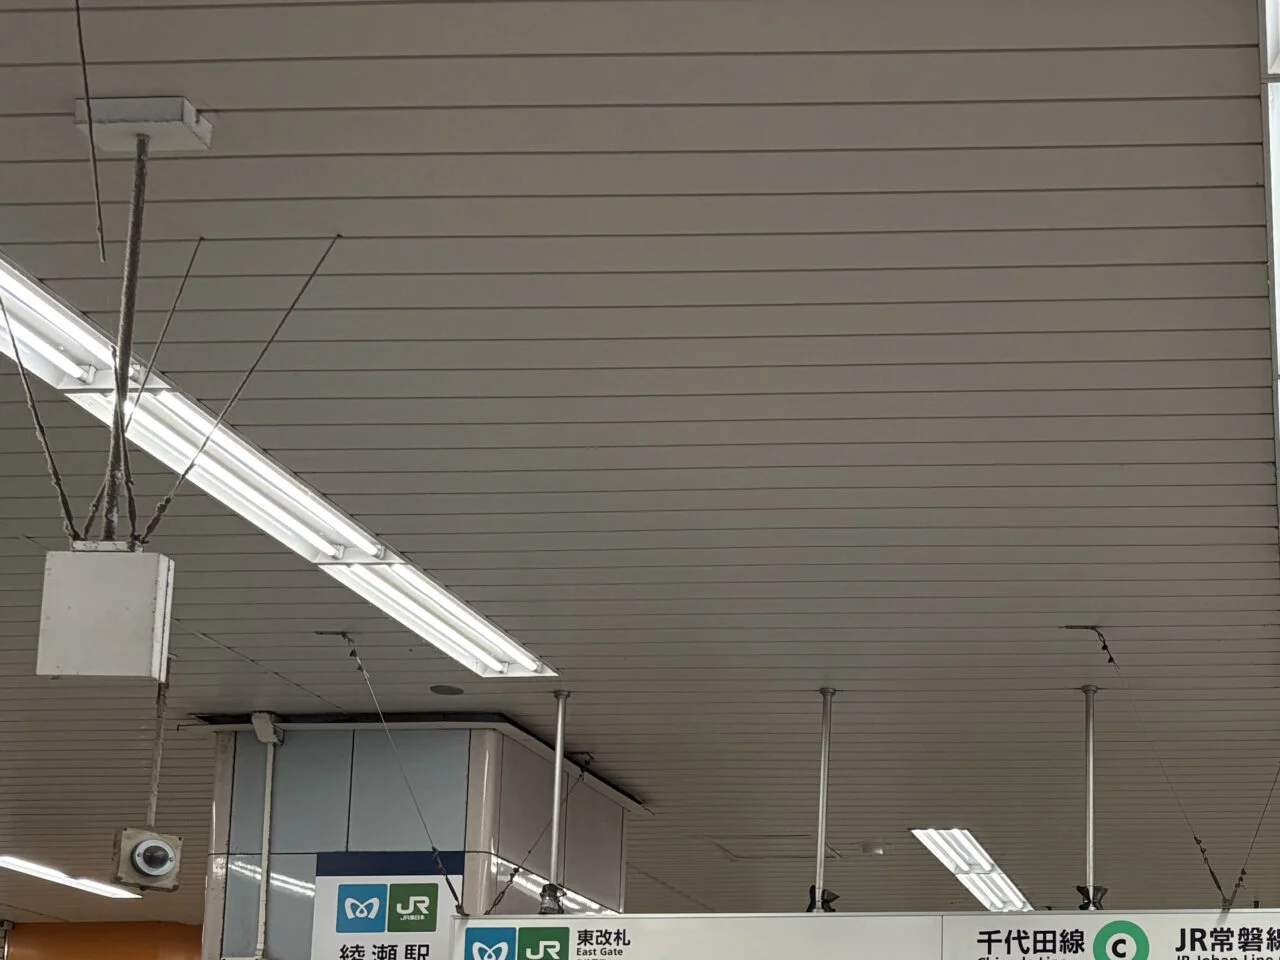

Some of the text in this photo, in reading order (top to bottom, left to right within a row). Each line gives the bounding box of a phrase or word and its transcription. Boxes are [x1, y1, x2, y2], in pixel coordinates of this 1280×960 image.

[397, 896, 430, 914] JR
[577, 929, 631, 947] 東改札
[977, 929, 1085, 955] 千代田線
[525, 940, 560, 960] JR
[576, 948, 623, 956] East Gate
[1111, 938, 1127, 958] C
